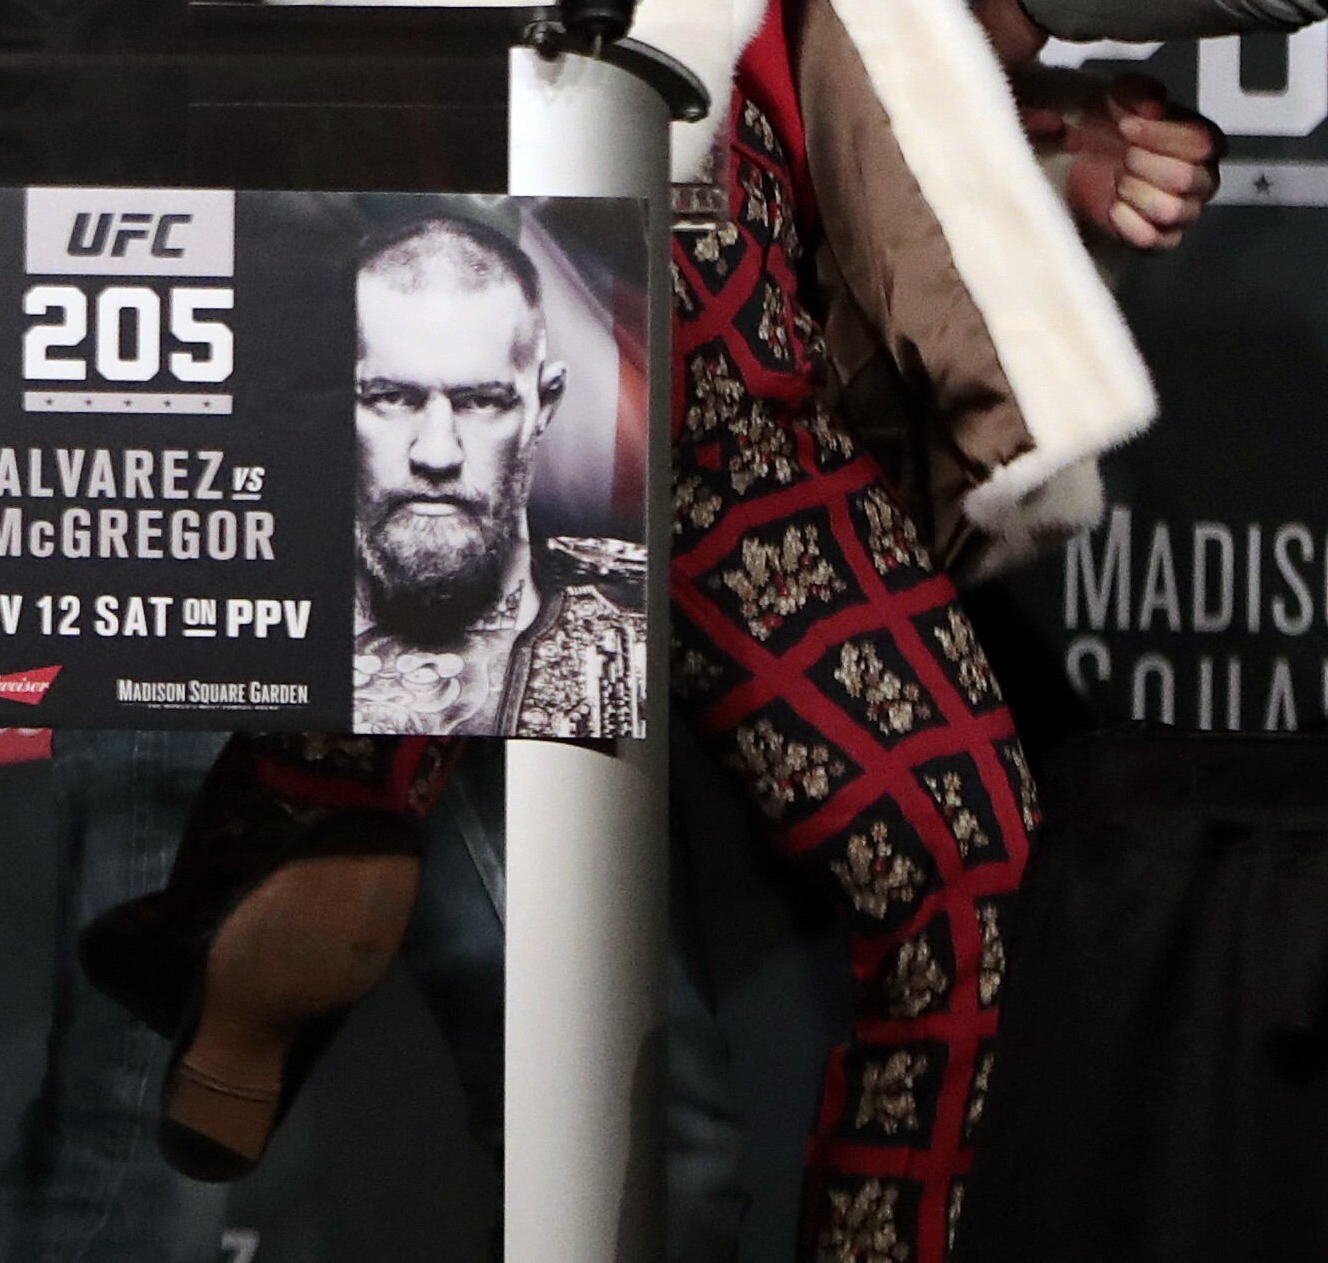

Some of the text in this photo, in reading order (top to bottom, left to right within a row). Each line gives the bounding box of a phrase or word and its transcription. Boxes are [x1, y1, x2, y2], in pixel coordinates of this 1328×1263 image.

[67, 212, 193, 258] UFC
[23, 285, 234, 383] 205
[1064, 505, 1328, 636] MADIS
[36, 594, 81, 636] 12
[94, 595, 174, 637] SAT
[182, 598, 217, 628] ON
[225, 599, 312, 639] PPV
[116, 679, 309, 704] MADISON SQUARE GARDEN
